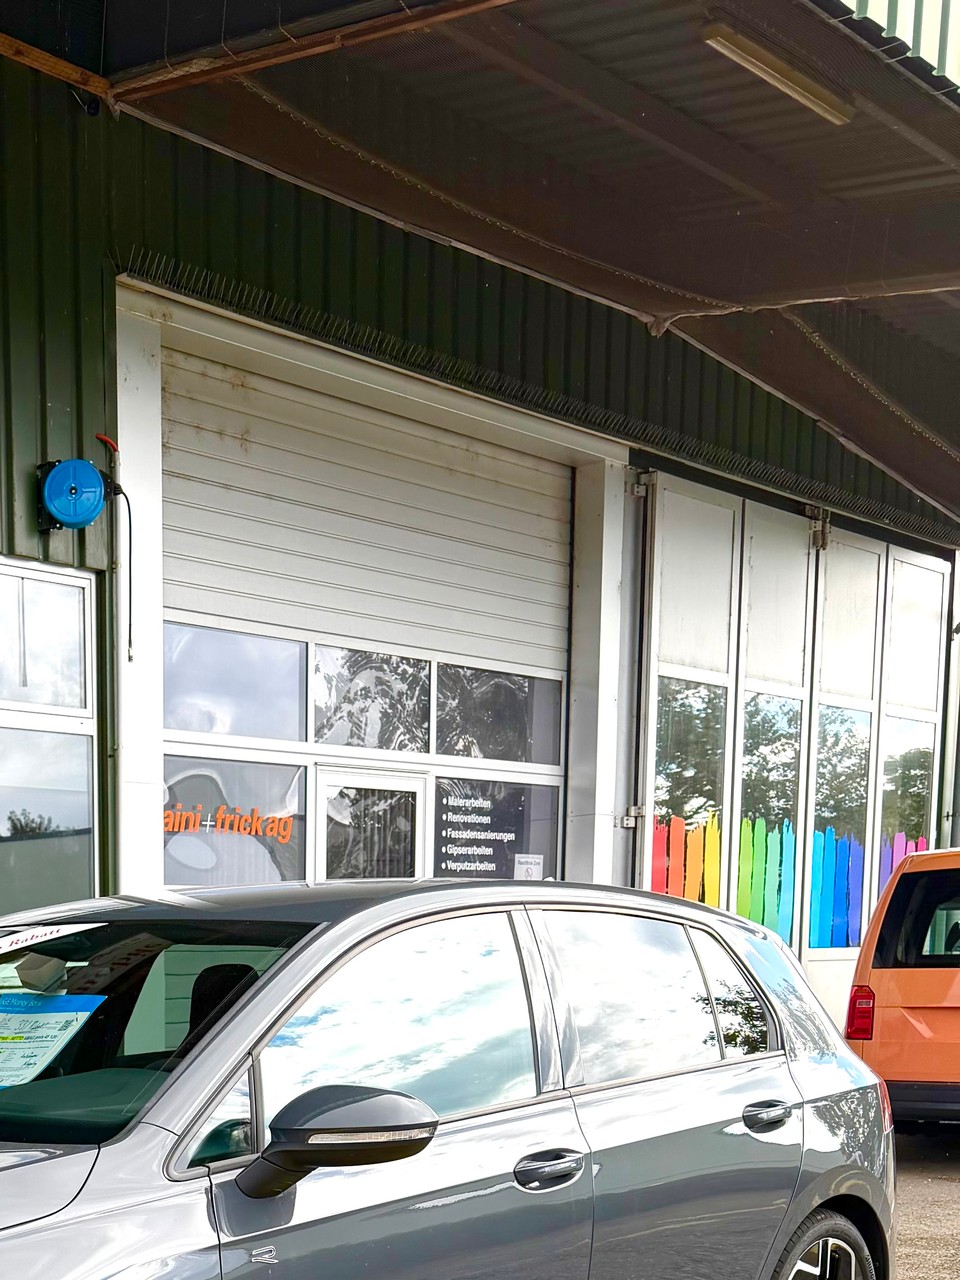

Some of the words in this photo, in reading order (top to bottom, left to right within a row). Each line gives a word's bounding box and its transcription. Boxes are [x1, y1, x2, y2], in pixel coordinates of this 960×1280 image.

[448, 796, 491, 808] Malerarbeiten
[448, 812, 491, 824] Renovationen
[447, 828, 515, 842] Fassadensanierungen
[446, 844, 493, 857] Gipserarbeiten
[446, 860, 496, 873] Verputzarbeiten
[8, 929, 61, 947] Rabatt
